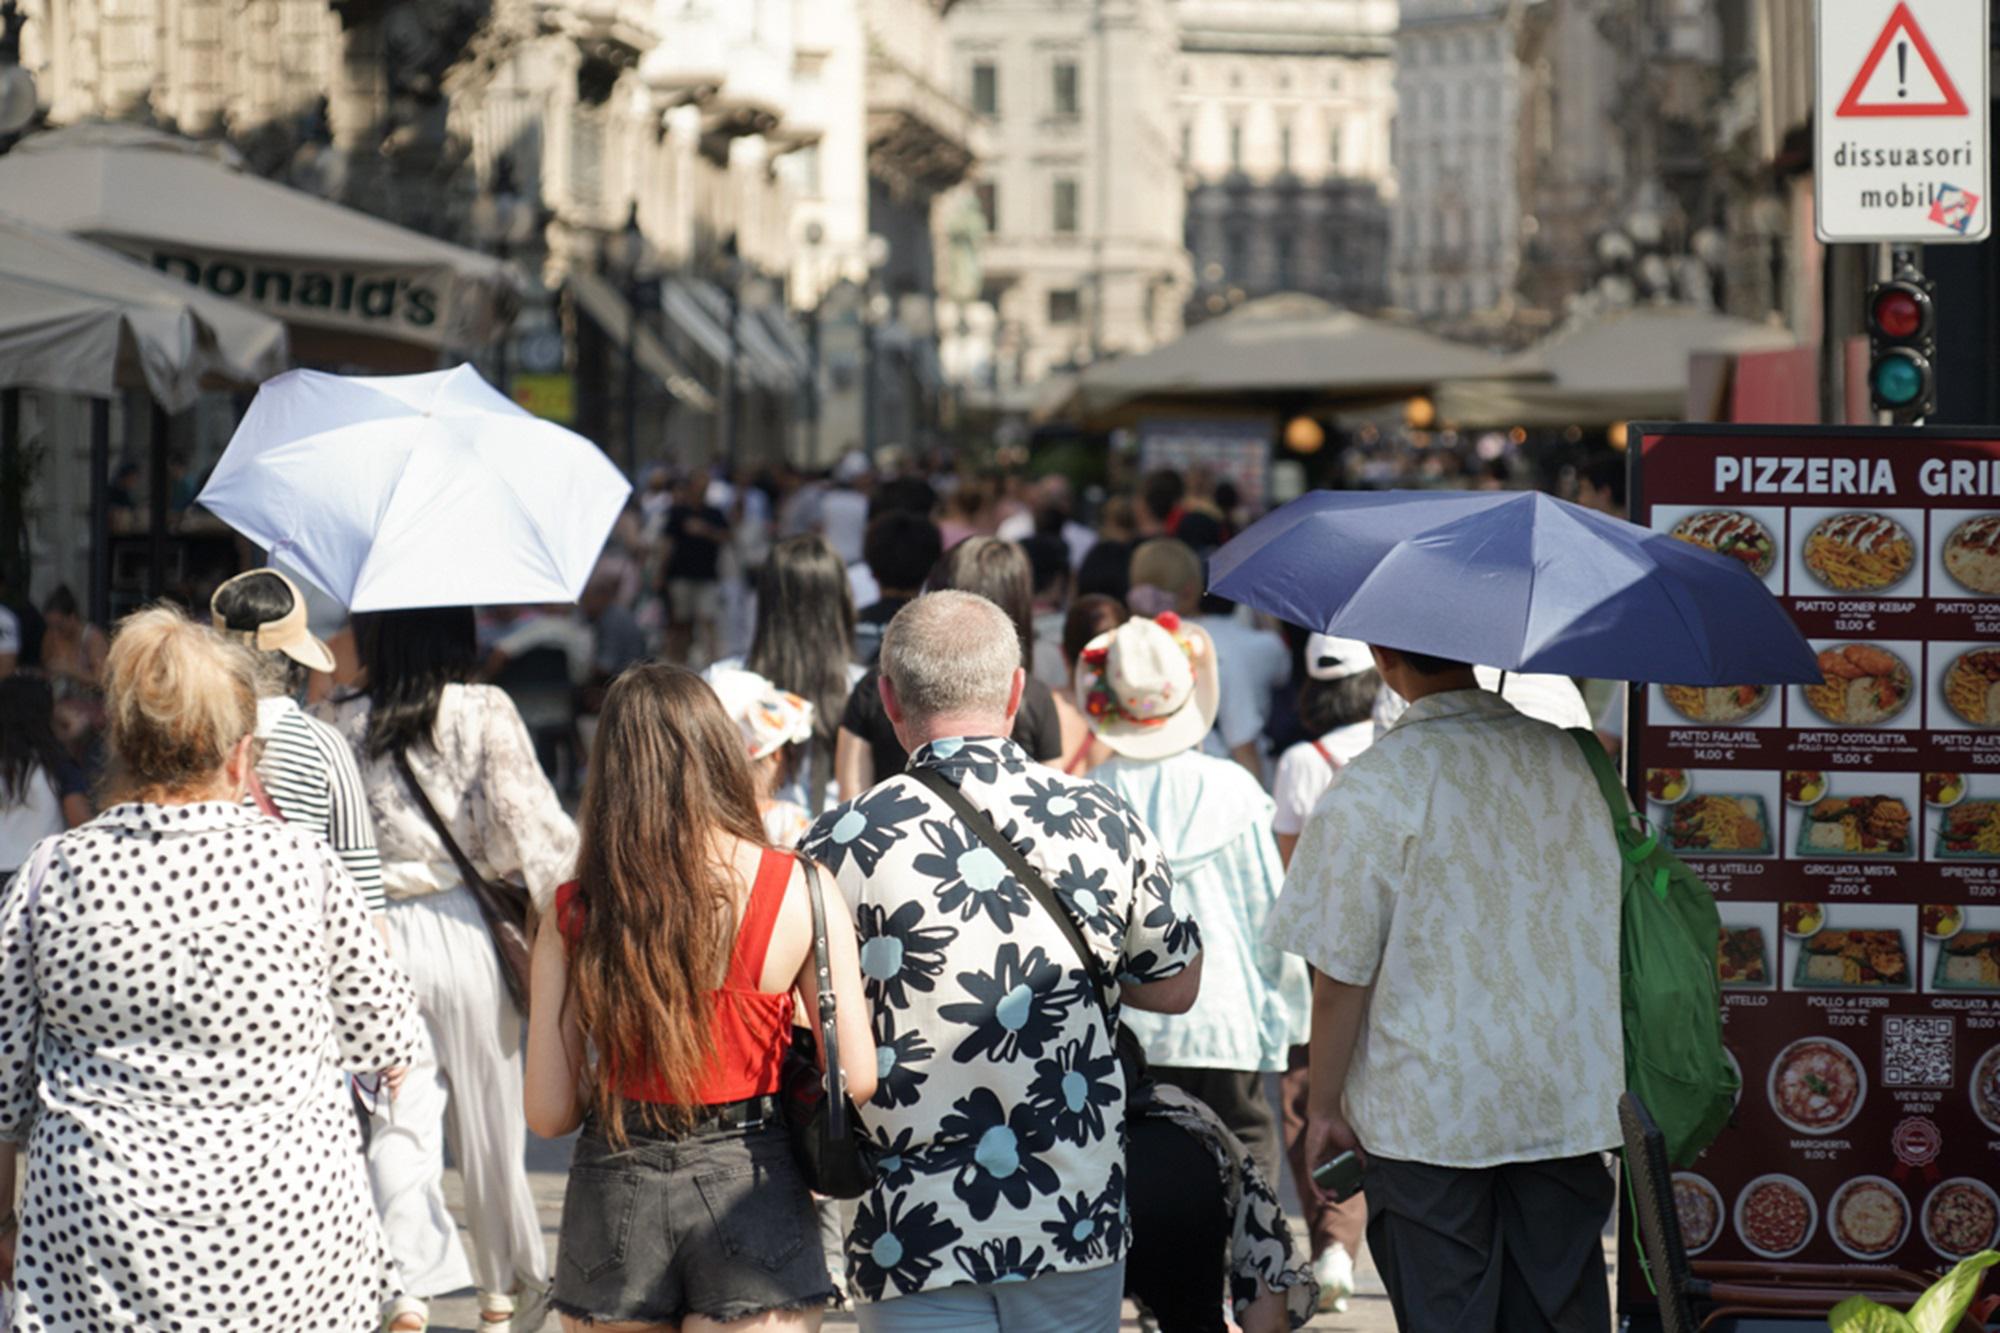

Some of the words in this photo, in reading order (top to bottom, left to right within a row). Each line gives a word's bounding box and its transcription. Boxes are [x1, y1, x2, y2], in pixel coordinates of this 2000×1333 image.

[1834, 141, 1972, 167] dissuasori
[1861, 183, 1935, 207] mobil
[1715, 456, 1896, 494] PIZZERIA
[1795, 601, 1836, 612] PIATTO
[1838, 601, 1877, 612] DONER
[1936, 603, 1975, 614] PIATTO
[1866, 620, 1876, 632] €
[1670, 730, 1710, 741] PIATTO
[1712, 731, 1759, 742] FALAFEL
[1798, 733, 1839, 744] PIATTO
[1931, 735, 1972, 745] PIATTO
[1725, 750, 1735, 761] €
[1863, 753, 1873, 765] €
[1719, 863, 1765, 875] VITELLO
[1803, 864, 1861, 875] GRIGLIATA
[1863, 866, 1897, 877] MISTA
[1862, 884, 1872, 896] €
[1723, 995, 1768, 1006] VITELLO
[1807, 996, 1844, 1007] POLLO
[1931, 998, 1989, 1009] GRIGLIATA
[1858, 1015, 1868, 1026] €
[1893, 1091, 1919, 1101] VIEW
[1921, 1091, 1942, 1102] OUR
[1903, 1103, 1934, 1113] MENU
[1790, 1139, 1851, 1150] MARGHERITA
